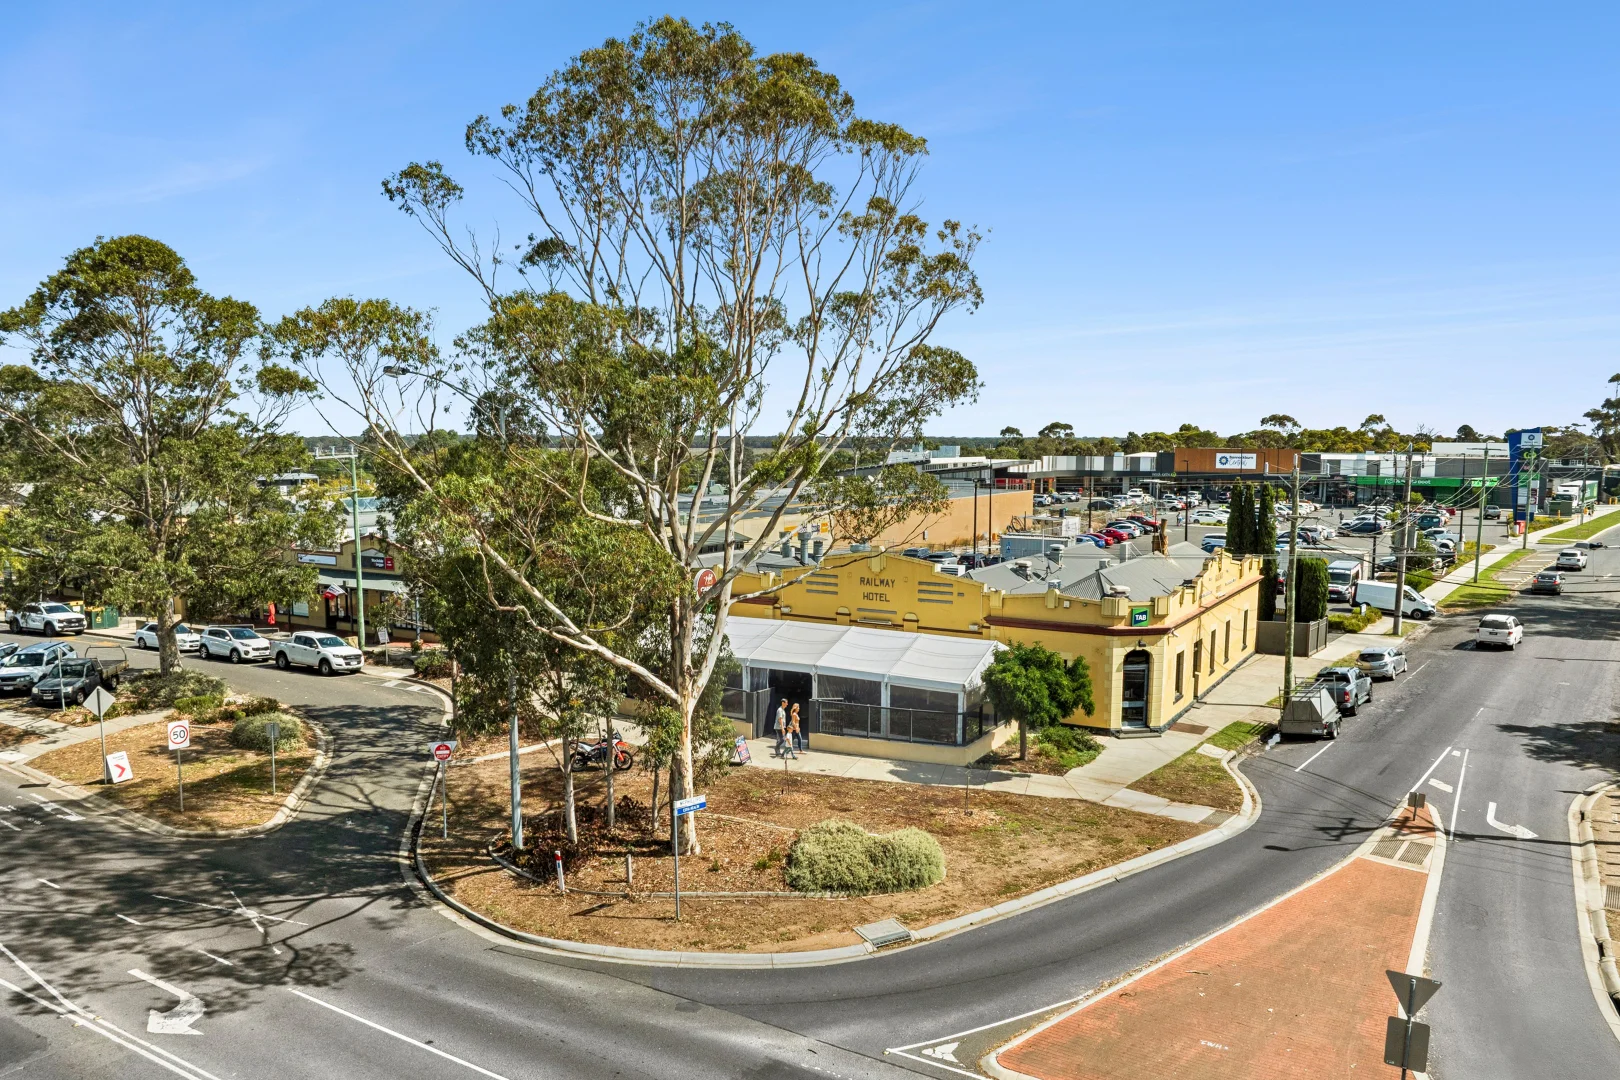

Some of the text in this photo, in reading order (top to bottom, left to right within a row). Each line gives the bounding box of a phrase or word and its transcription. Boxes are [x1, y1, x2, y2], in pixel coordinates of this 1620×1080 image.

[860, 576, 896, 588] RAILWAY
[862, 592, 890, 602] HOTEL
[172, 730, 186, 740] 50
